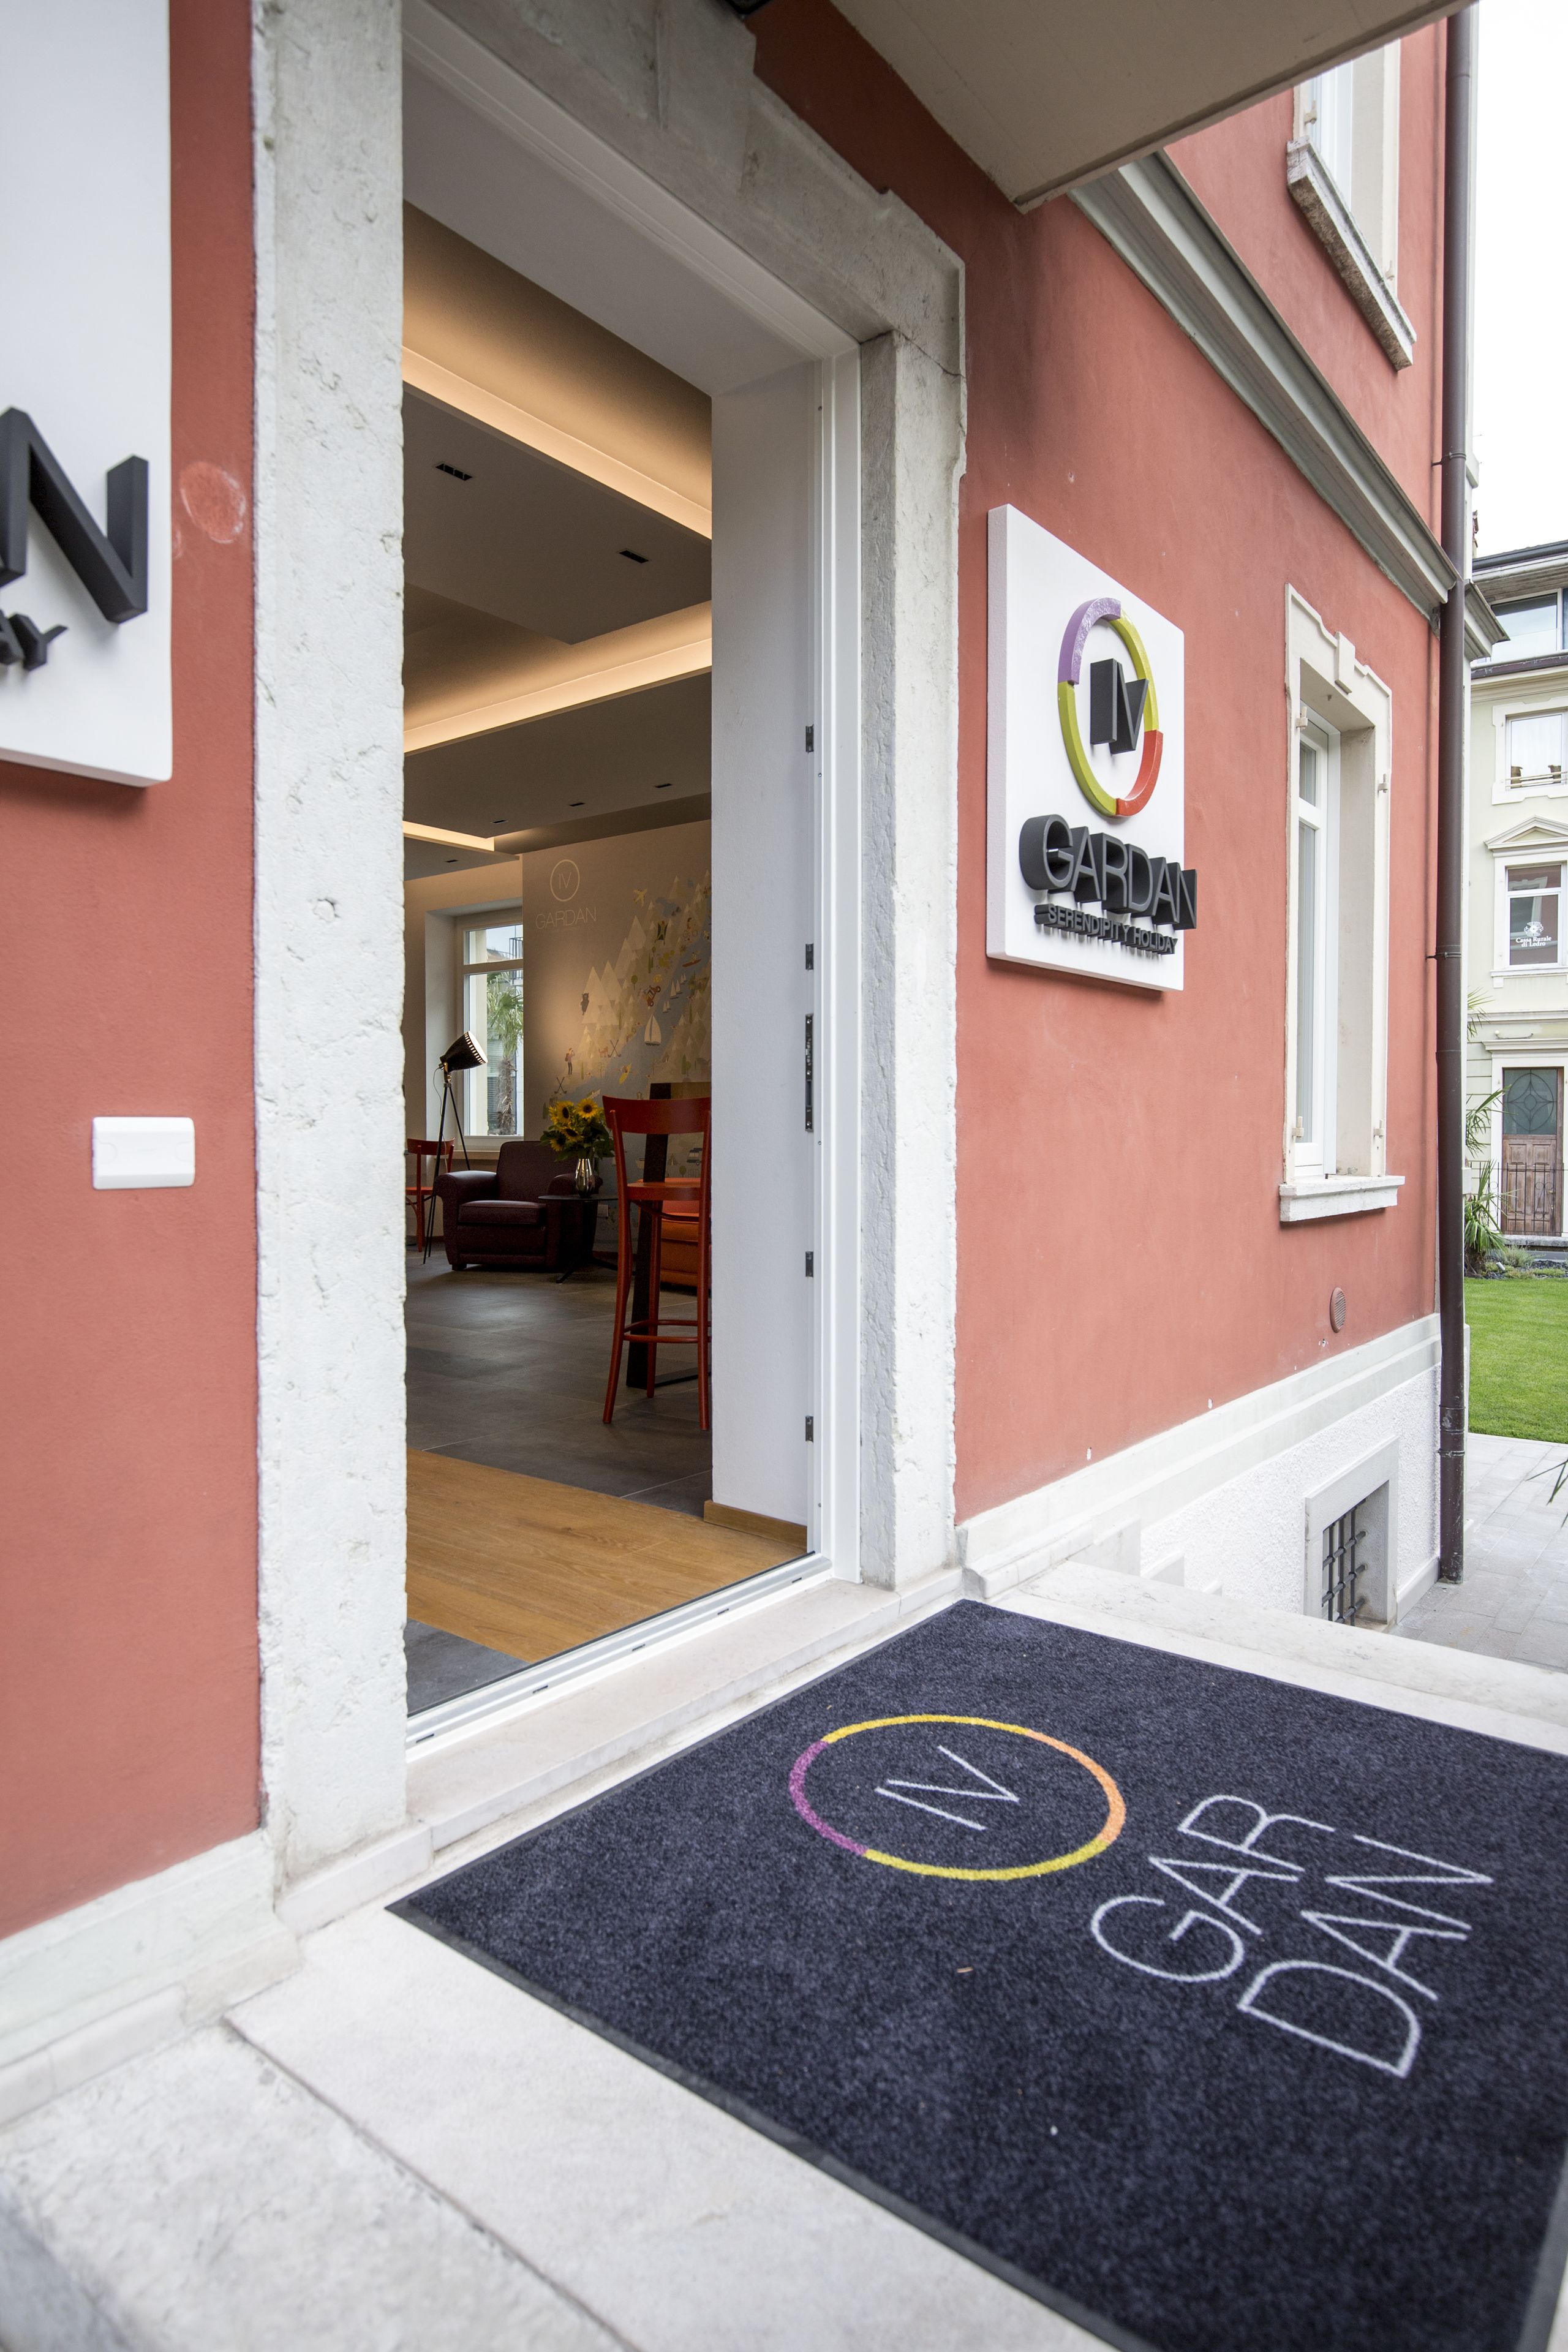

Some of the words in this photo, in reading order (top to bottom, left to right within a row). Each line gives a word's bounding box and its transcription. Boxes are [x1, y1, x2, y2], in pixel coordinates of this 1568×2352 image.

[535, 906, 597, 929] GARDAN
[1019, 814, 1197, 930] GARDAN
[1035, 903, 1130, 947] SERENDIPITY
[1130, 925, 1178, 955] HOLIDAY
[1090, 1794, 1336, 1982] GAR
[1236, 1834, 1494, 2079] DAN
